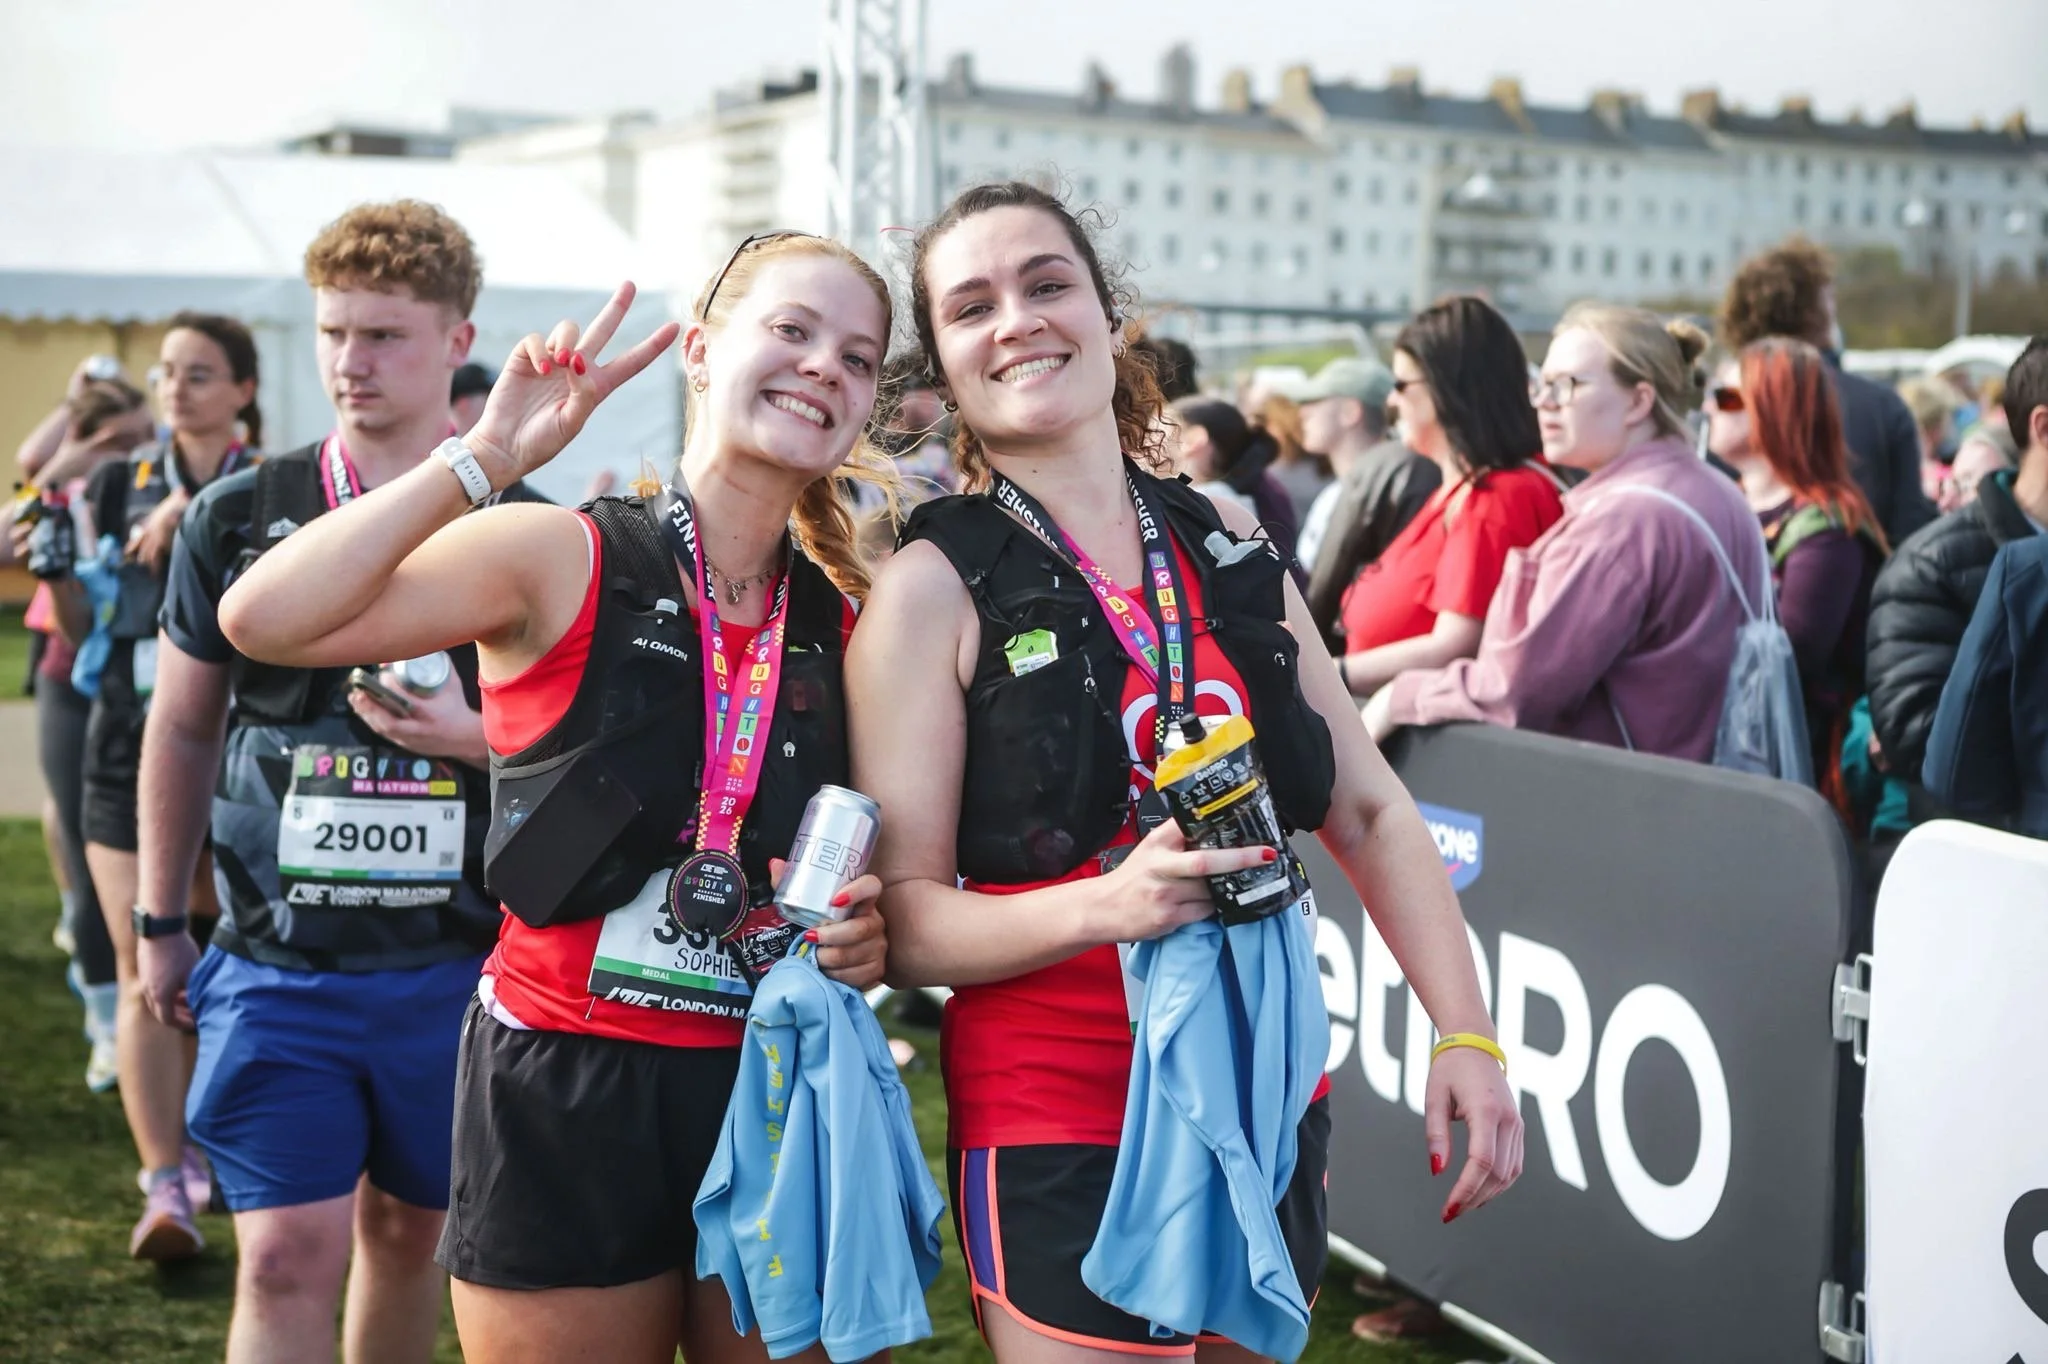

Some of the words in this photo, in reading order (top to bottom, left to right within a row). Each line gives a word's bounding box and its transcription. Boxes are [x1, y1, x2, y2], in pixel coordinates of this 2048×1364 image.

[314, 823, 428, 853] 29001
[788, 833, 863, 881] TER
[756, 927, 791, 942] GetPRO
[641, 967, 671, 981] MEDAL
[674, 947, 741, 978] SOPHIE
[661, 996, 730, 1018] LONDON
